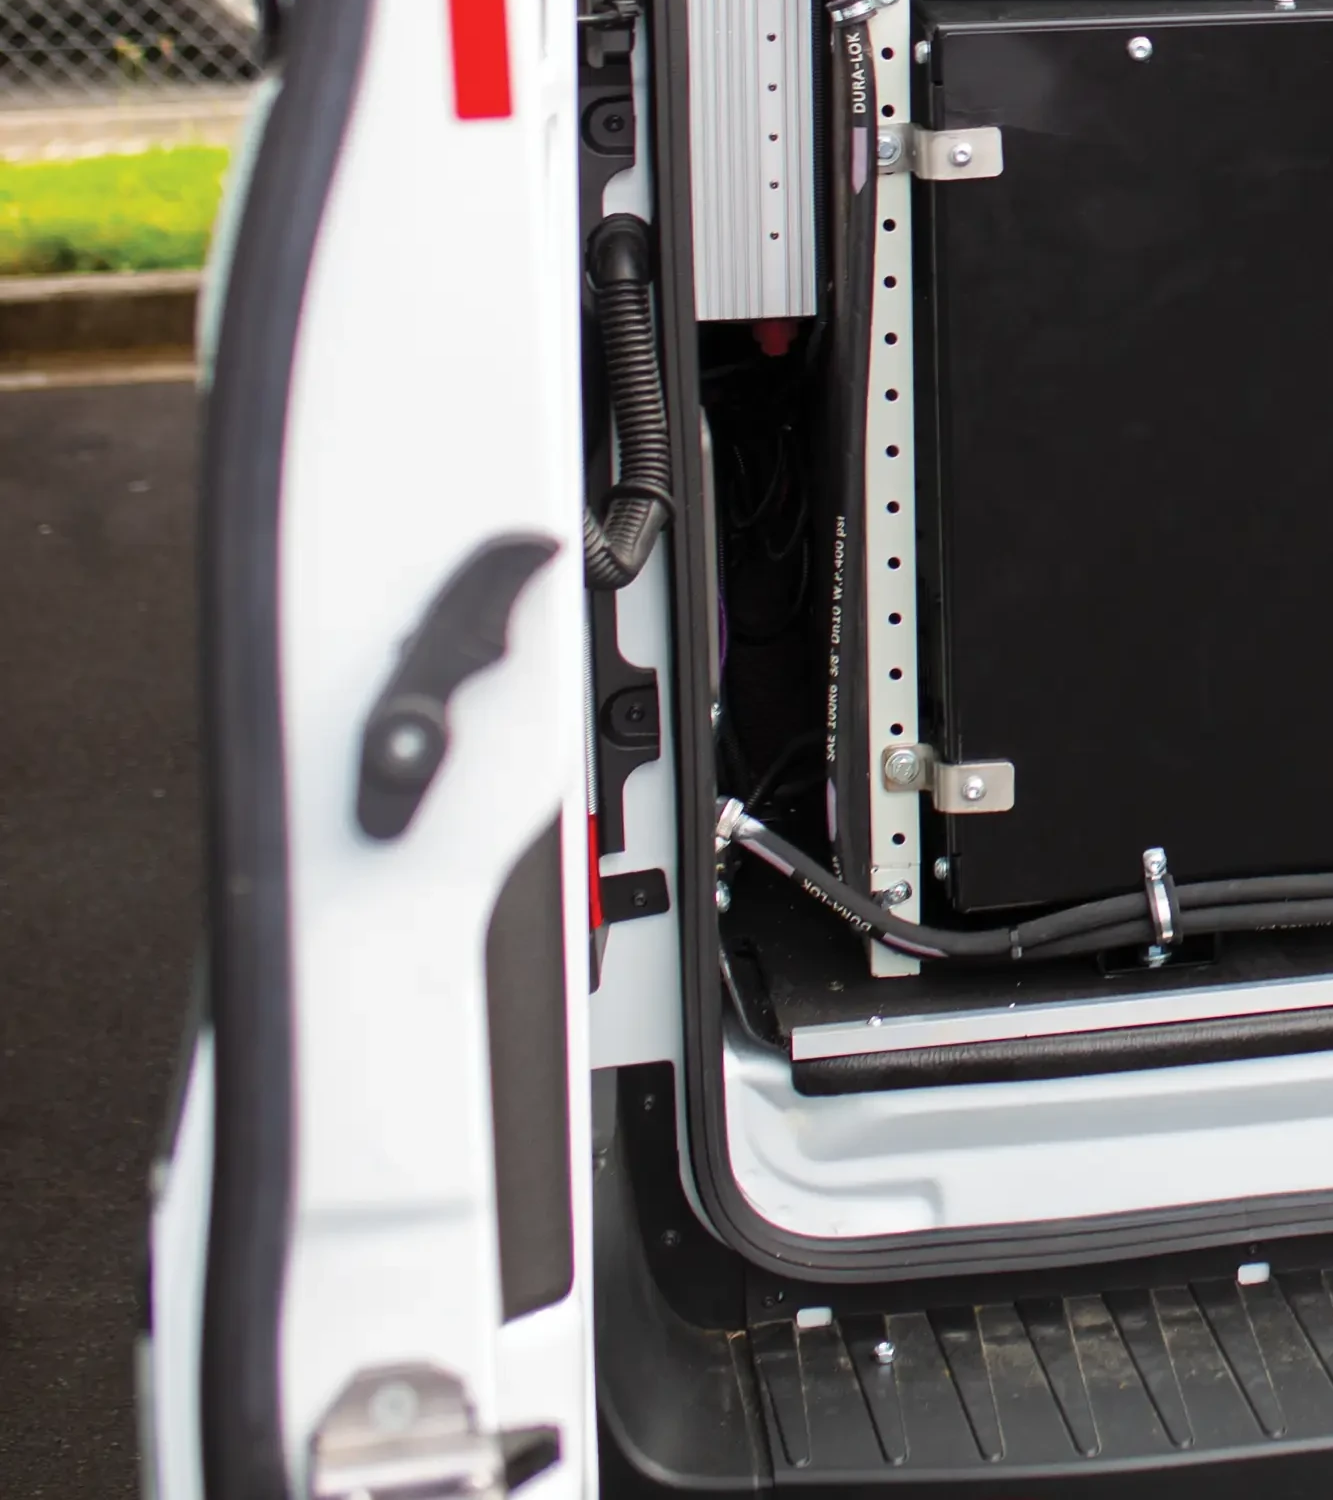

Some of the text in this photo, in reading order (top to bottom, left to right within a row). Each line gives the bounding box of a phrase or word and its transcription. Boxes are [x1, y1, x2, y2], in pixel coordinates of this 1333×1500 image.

[847, 31, 867, 115] DURA-LOK
[835, 515, 848, 538] psi
[832, 540, 845, 600] W.P.400
[831, 605, 841, 644] Dn10
[827, 684, 838, 730] 100R6
[826, 734, 836, 762] SAE
[801, 878, 873, 933] DURA-LOK
